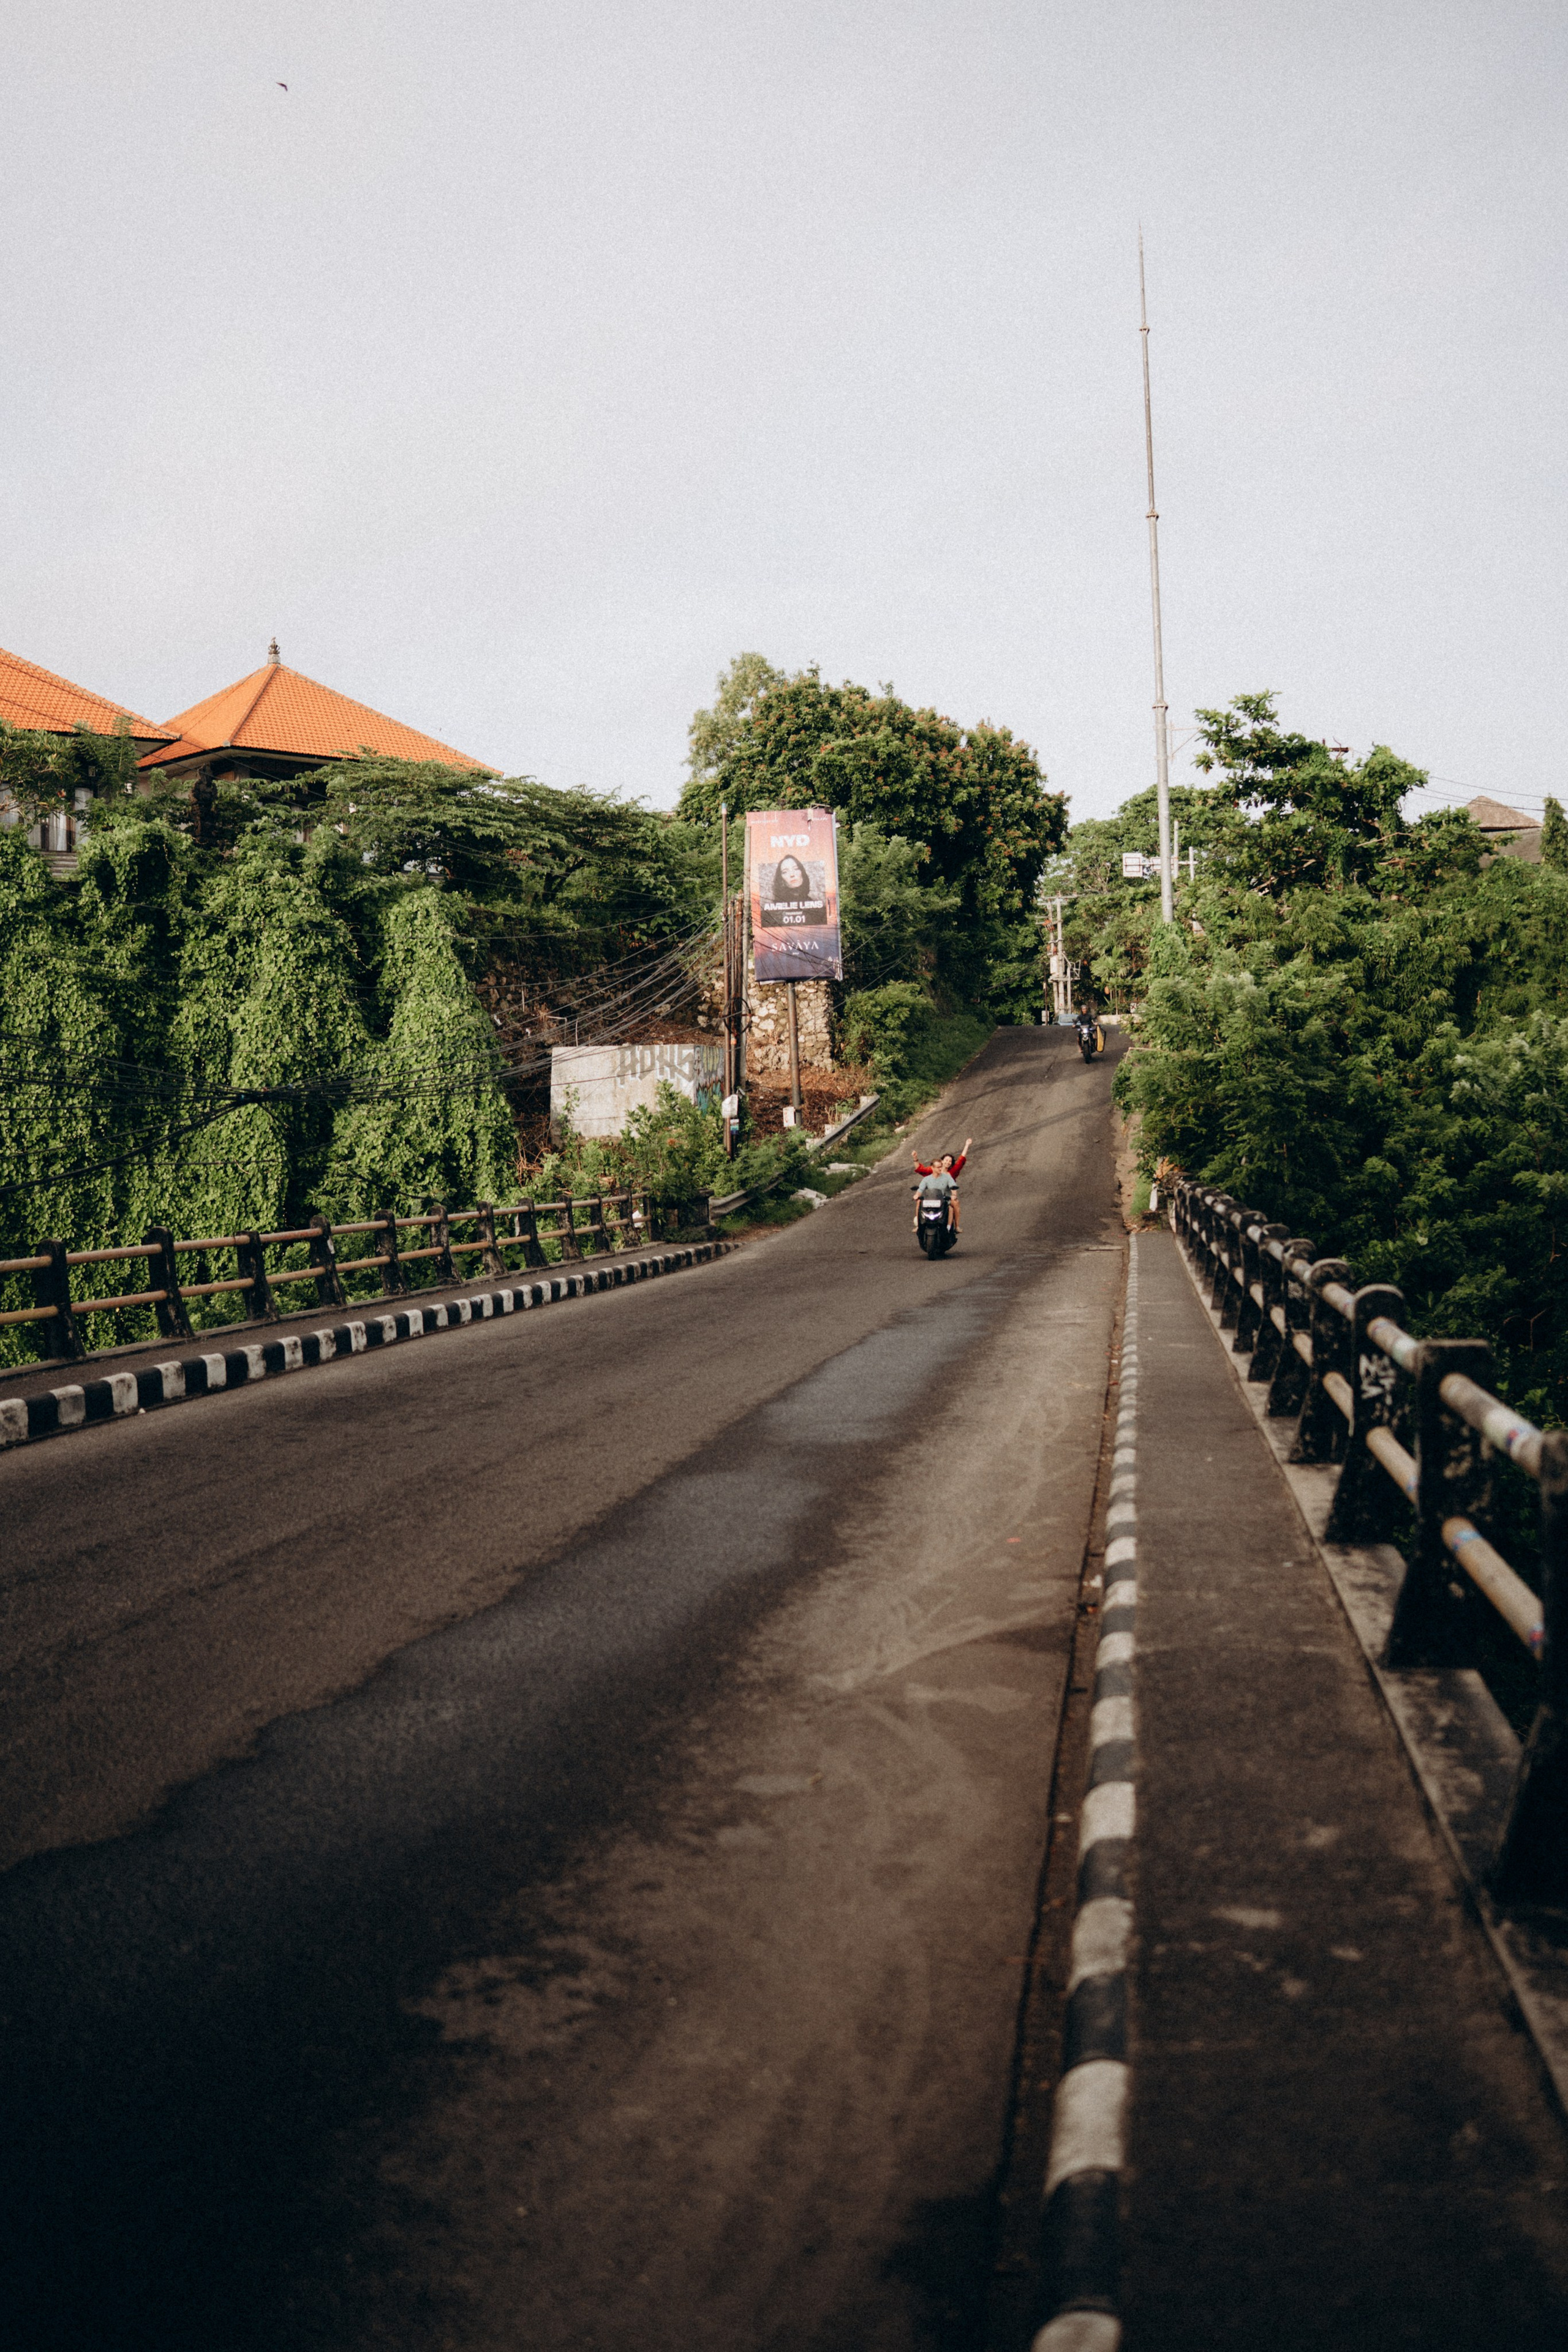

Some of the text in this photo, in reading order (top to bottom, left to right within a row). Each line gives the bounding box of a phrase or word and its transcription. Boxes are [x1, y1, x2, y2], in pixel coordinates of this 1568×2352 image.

[770, 834, 810, 848] NYD
[764, 900, 823, 911] AMELIE LENS
[783, 915, 806, 924] 01.01
